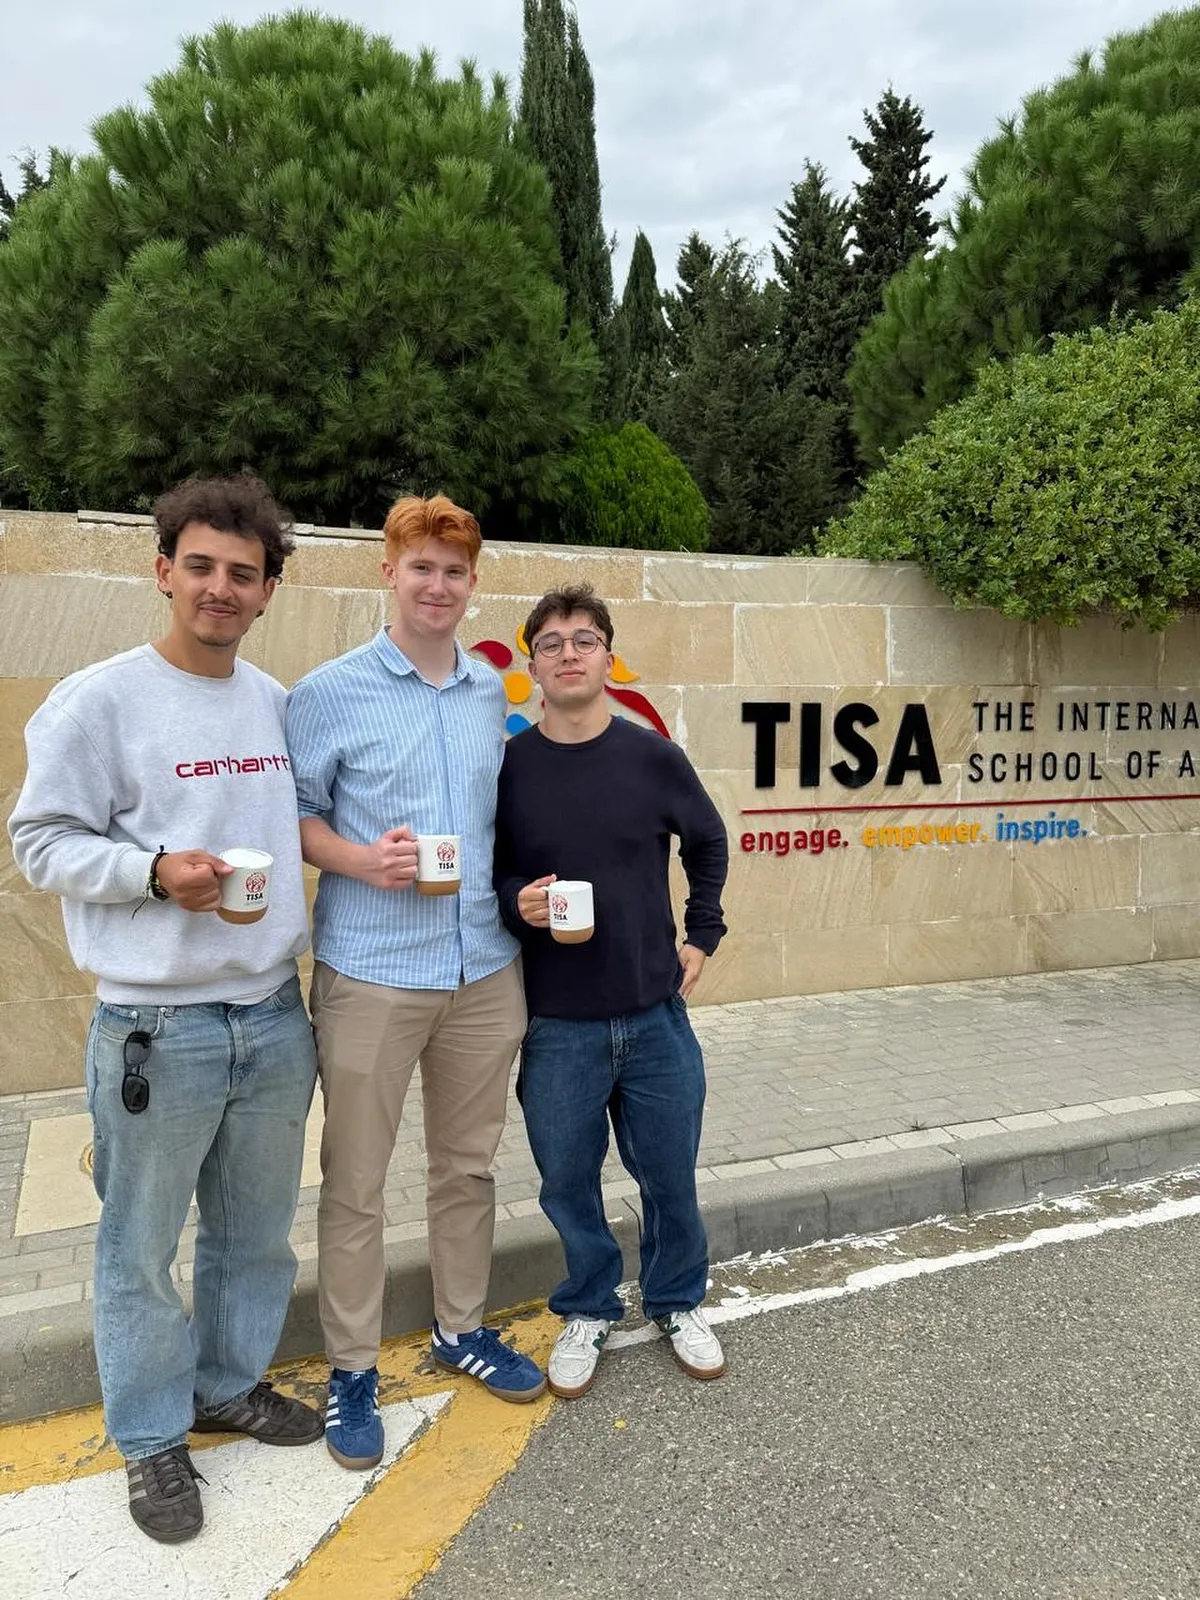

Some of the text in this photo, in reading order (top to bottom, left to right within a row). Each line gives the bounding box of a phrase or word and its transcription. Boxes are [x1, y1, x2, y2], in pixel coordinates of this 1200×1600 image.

[973, 701, 1200, 732] THE INTERNA
[741, 702, 943, 788] TISA
[175, 754, 291, 780] carhartt
[968, 749, 1196, 784] SCHOOL OF A
[740, 811, 1087, 856] engage. empower. inspire.
[438, 862, 455, 870] TISA
[246, 892, 264, 901] TISA
